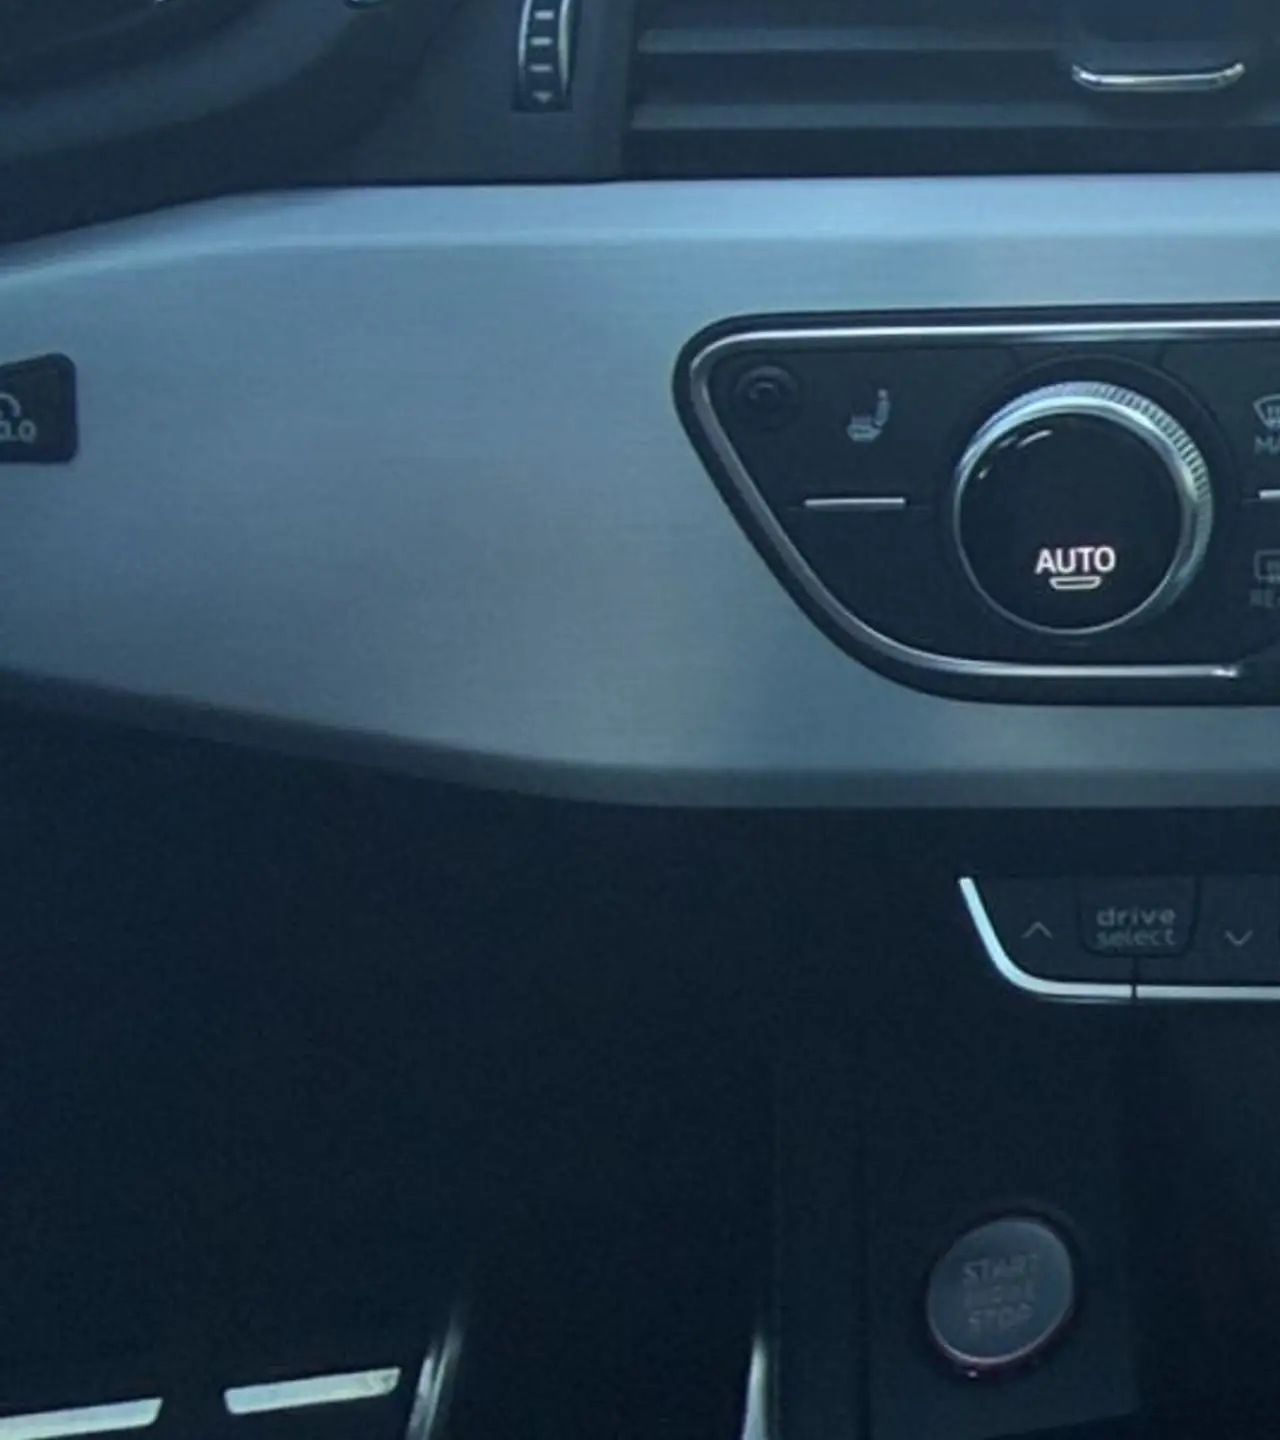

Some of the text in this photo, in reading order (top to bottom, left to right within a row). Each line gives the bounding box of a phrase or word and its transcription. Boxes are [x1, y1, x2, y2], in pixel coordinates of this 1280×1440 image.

[1035, 545, 1117, 576] AUTO
[1096, 905, 1177, 927] drive
[1096, 926, 1177, 948] select
